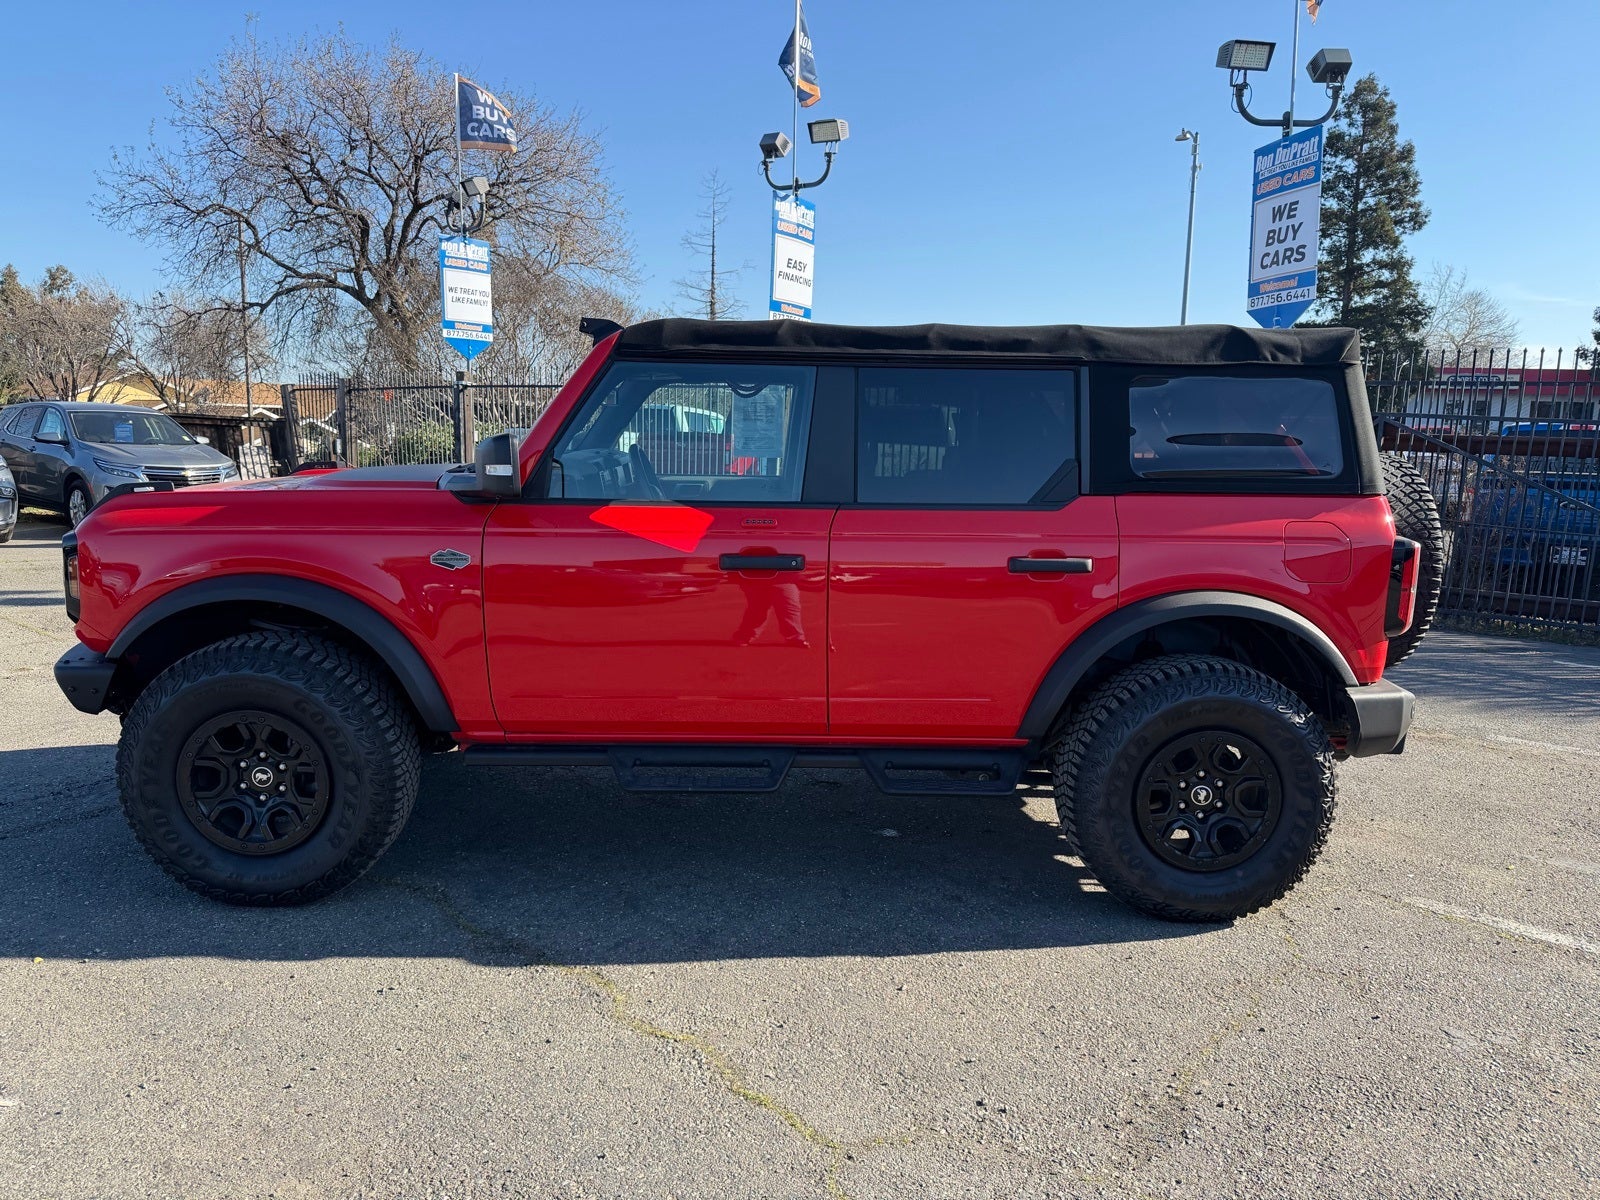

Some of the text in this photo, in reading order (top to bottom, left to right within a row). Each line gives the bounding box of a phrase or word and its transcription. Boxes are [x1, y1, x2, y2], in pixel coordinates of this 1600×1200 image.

[476, 89, 503, 109] W
[472, 105, 508, 124] BUY
[467, 122, 517, 142] CARS
[1256, 135, 1319, 173] Ron DuPratt
[1257, 166, 1316, 195] USED CARS
[1271, 200, 1300, 224] WE
[1265, 221, 1304, 247] BUY
[786, 258, 807, 273] EASY
[1260, 244, 1307, 270] CARS
[778, 270, 812, 288] FINANCING
[448, 286, 490, 298] WE TREAT YOU
[451, 295, 489, 307] LIKE FAMILY!
[1250, 288, 1311, 308] 877.756.6441
[446, 329, 491, 341] 877.756.6441
